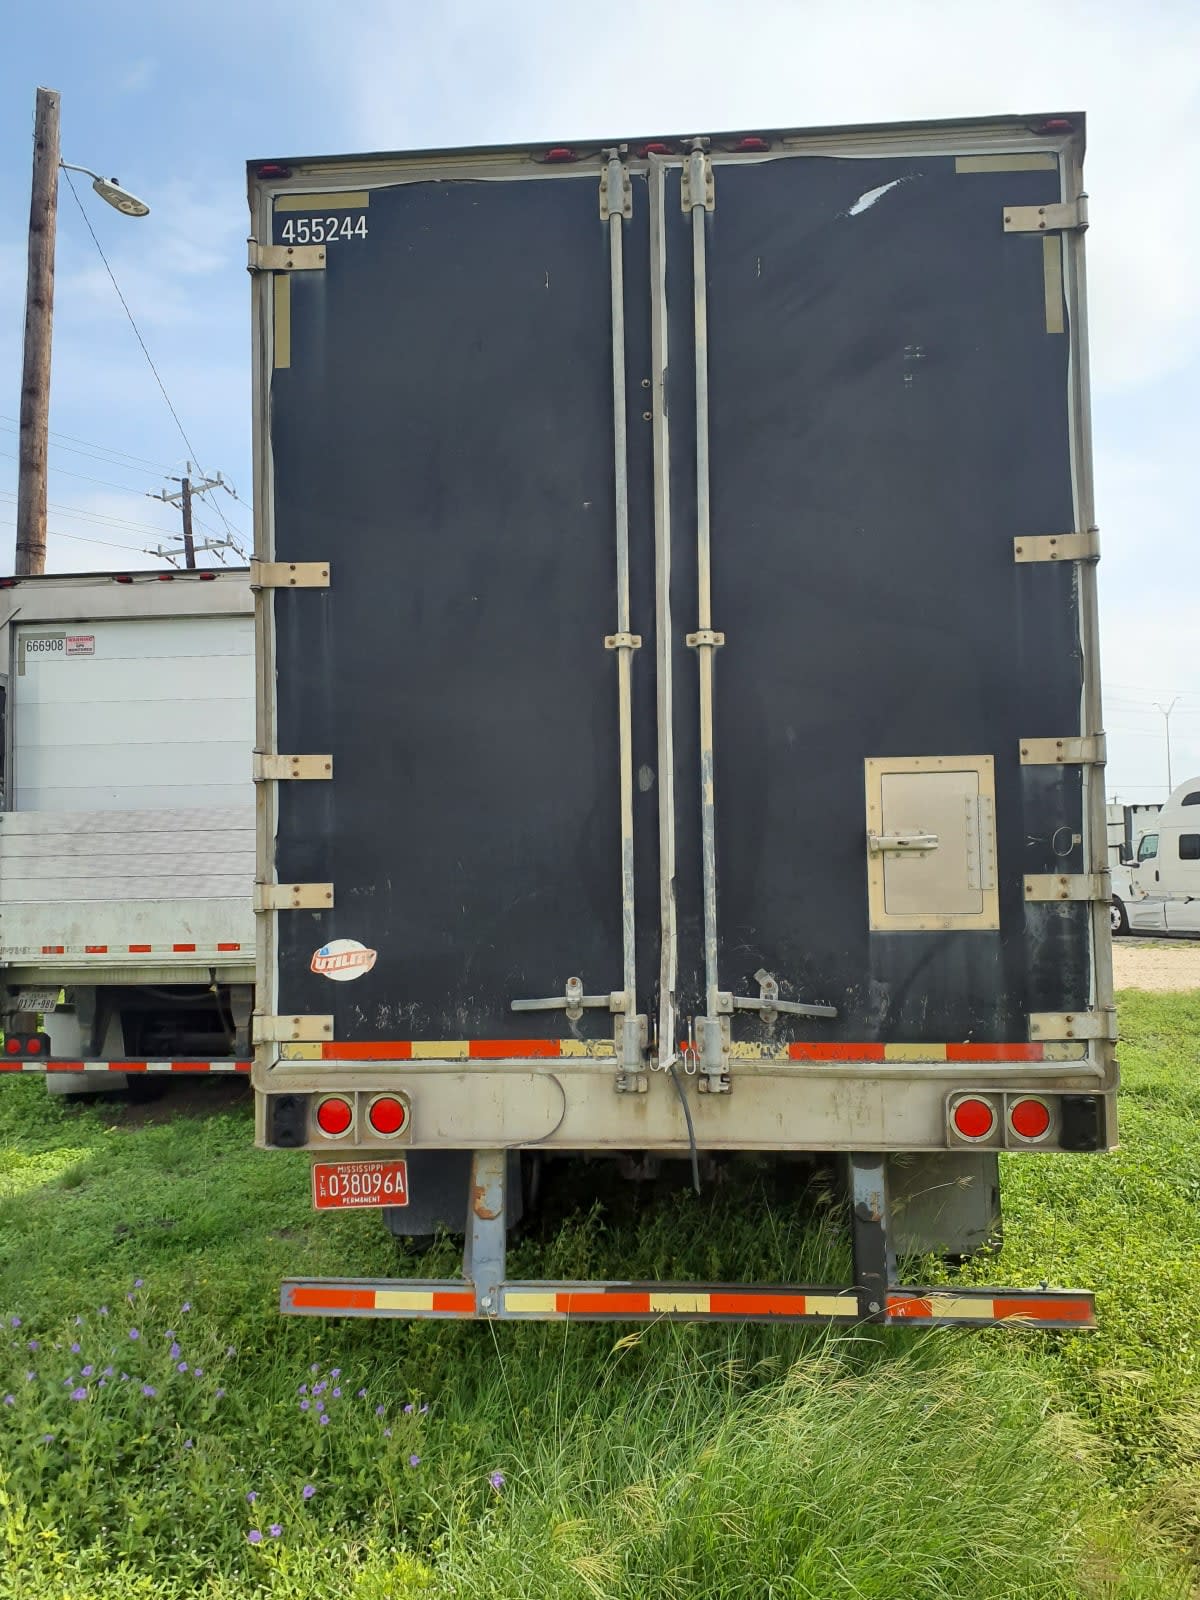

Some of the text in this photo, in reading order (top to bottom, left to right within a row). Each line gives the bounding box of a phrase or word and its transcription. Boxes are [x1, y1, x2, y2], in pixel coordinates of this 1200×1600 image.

[281, 215, 369, 243] 455244
[26, 640, 63, 652] 666908
[337, 1164, 383, 1174] MISSISSIPPI
[329, 1172, 404, 1197] 038096A
[342, 1195, 381, 1204] PERMANENT
